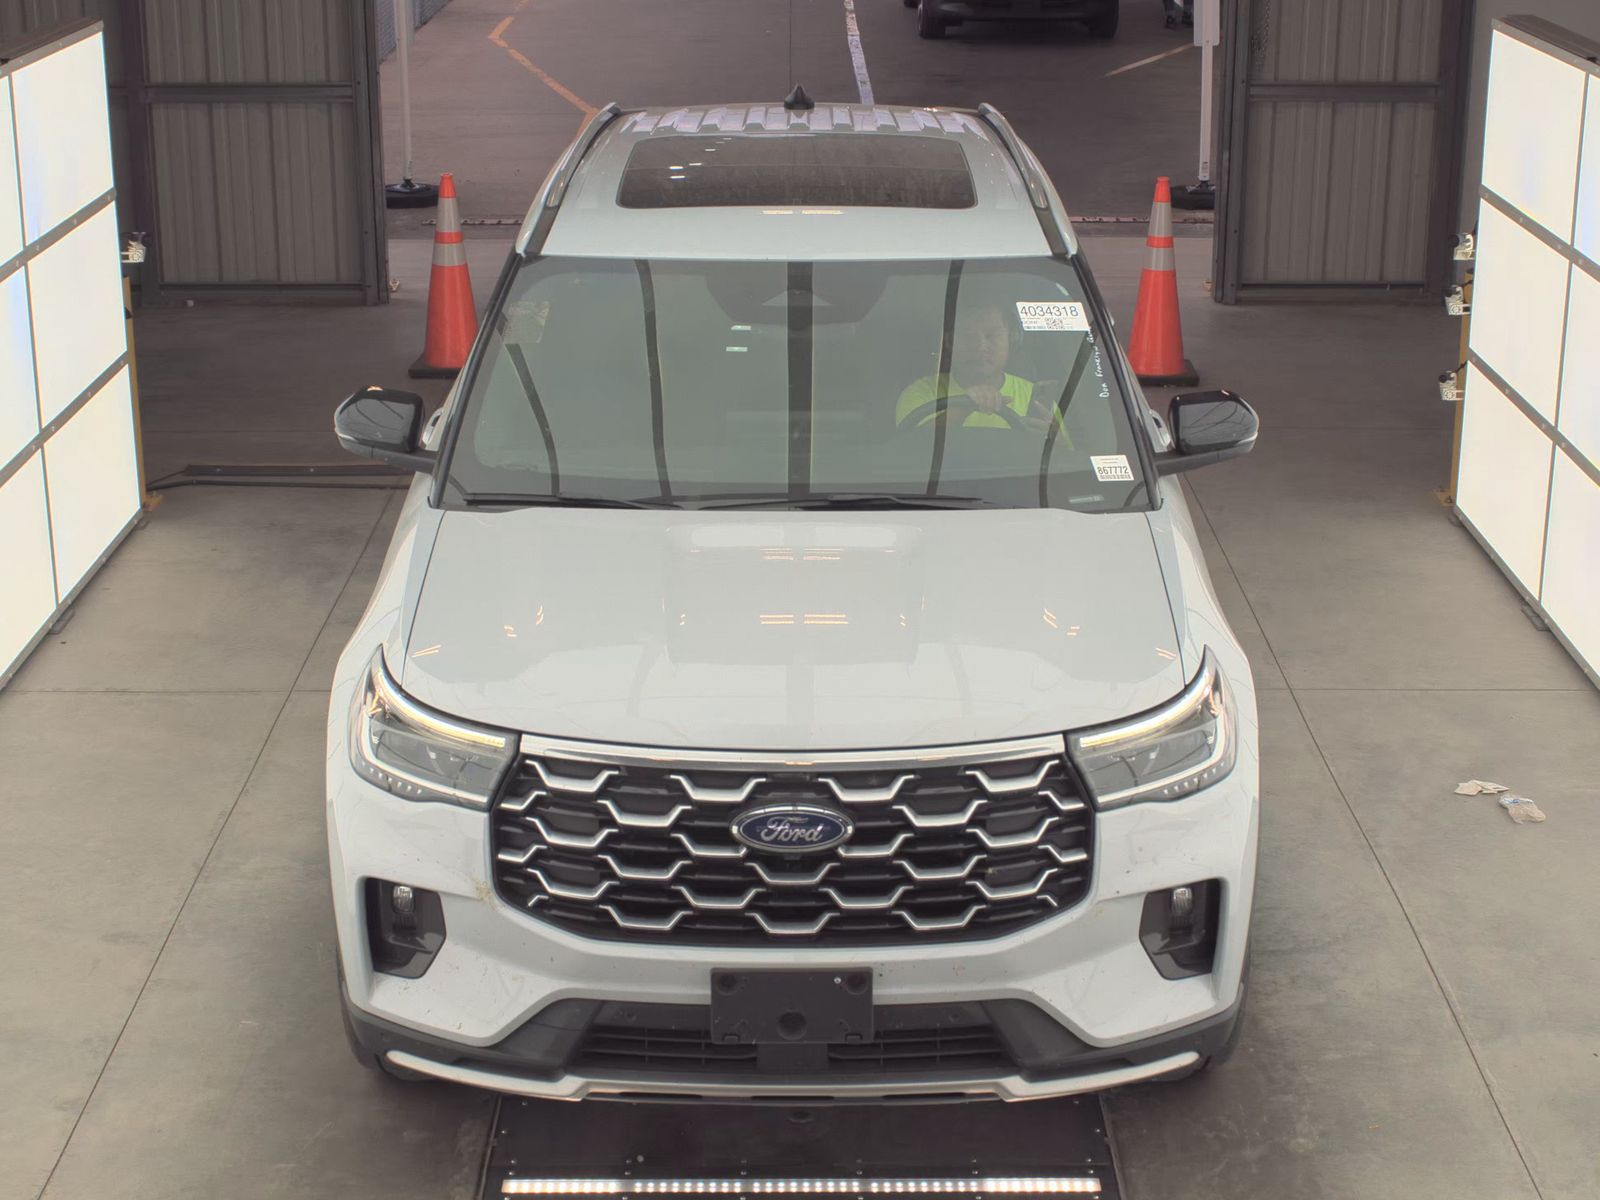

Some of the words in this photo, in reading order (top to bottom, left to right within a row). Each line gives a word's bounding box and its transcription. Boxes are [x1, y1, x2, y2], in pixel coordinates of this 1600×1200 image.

[1020, 305, 1079, 317] 4034318
[1097, 466, 1129, 475] 867772
[760, 815, 823, 842] Ford
